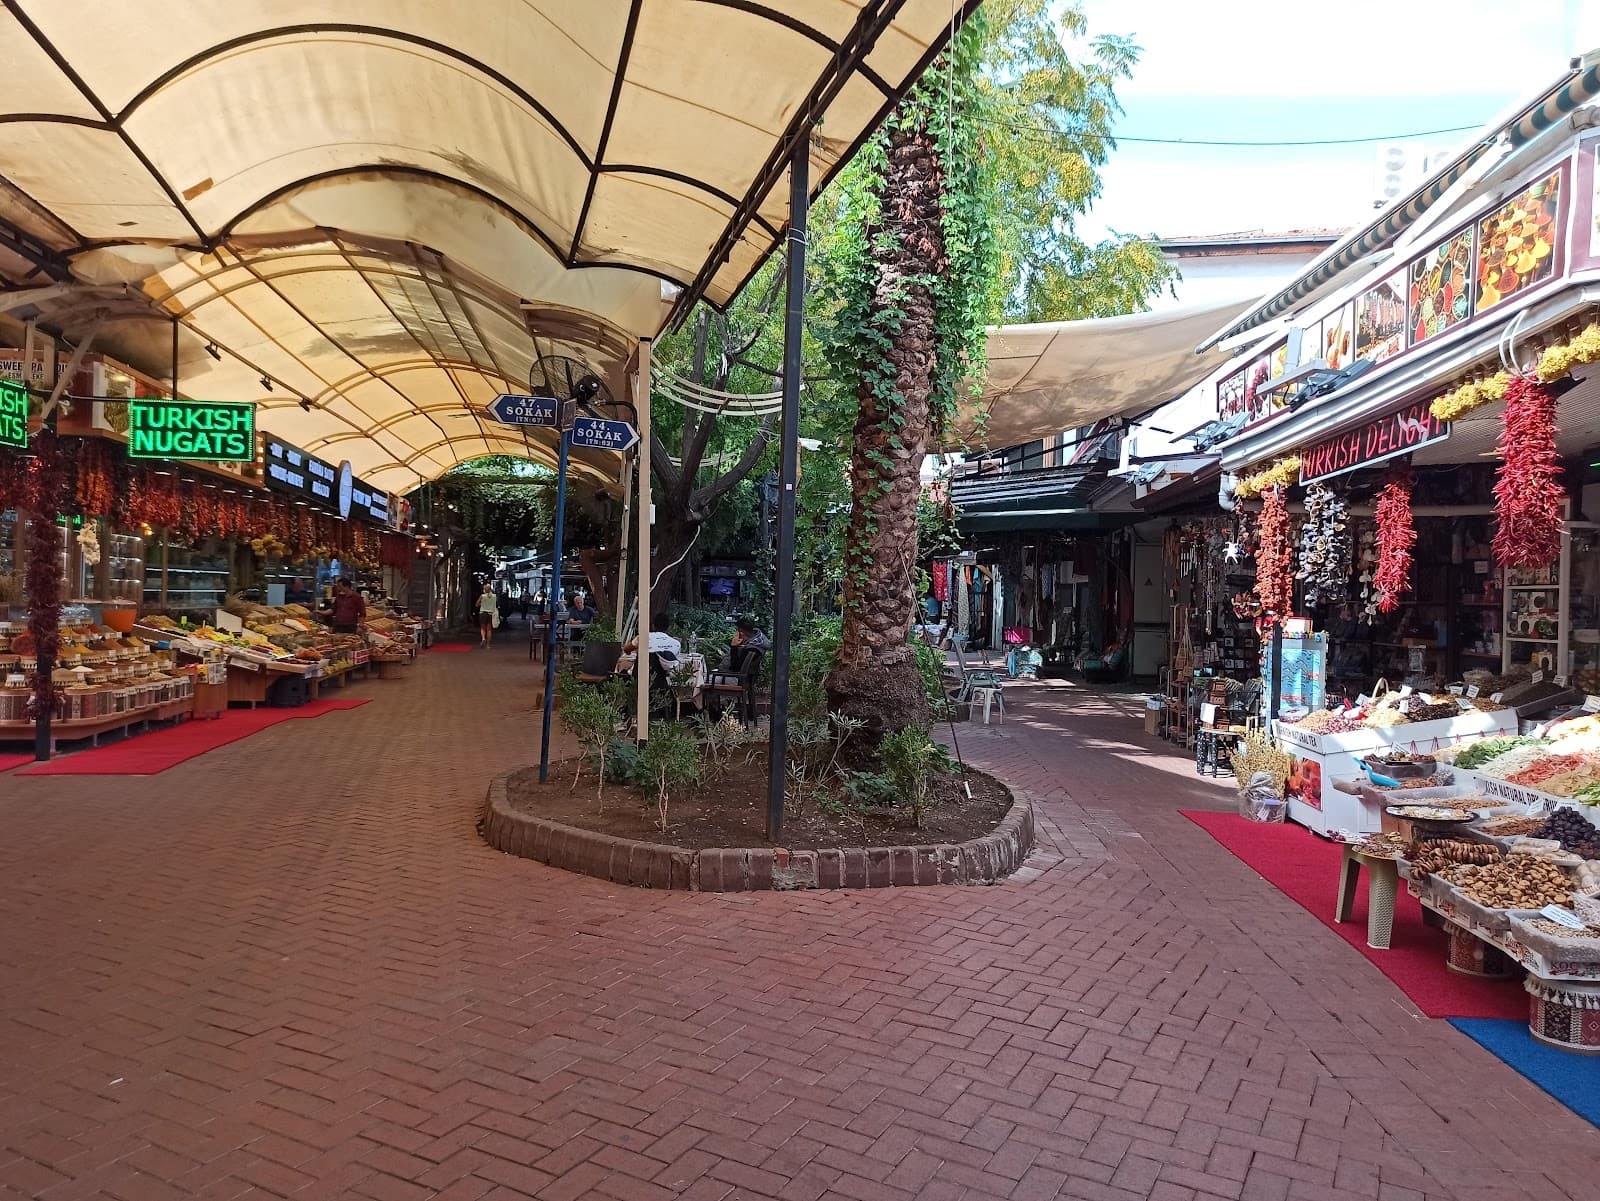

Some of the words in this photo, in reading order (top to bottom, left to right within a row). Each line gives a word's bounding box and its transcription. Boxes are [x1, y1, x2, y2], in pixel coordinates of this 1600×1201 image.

[131, 405, 250, 431] TURKISH
[506, 406, 553, 418] SOKAK
[135, 430, 245, 454] NUGATS
[577, 427, 622, 441] SOKAK
[1301, 430, 1362, 478] TURKISH
[1499, 784, 1527, 805] NATURAL
